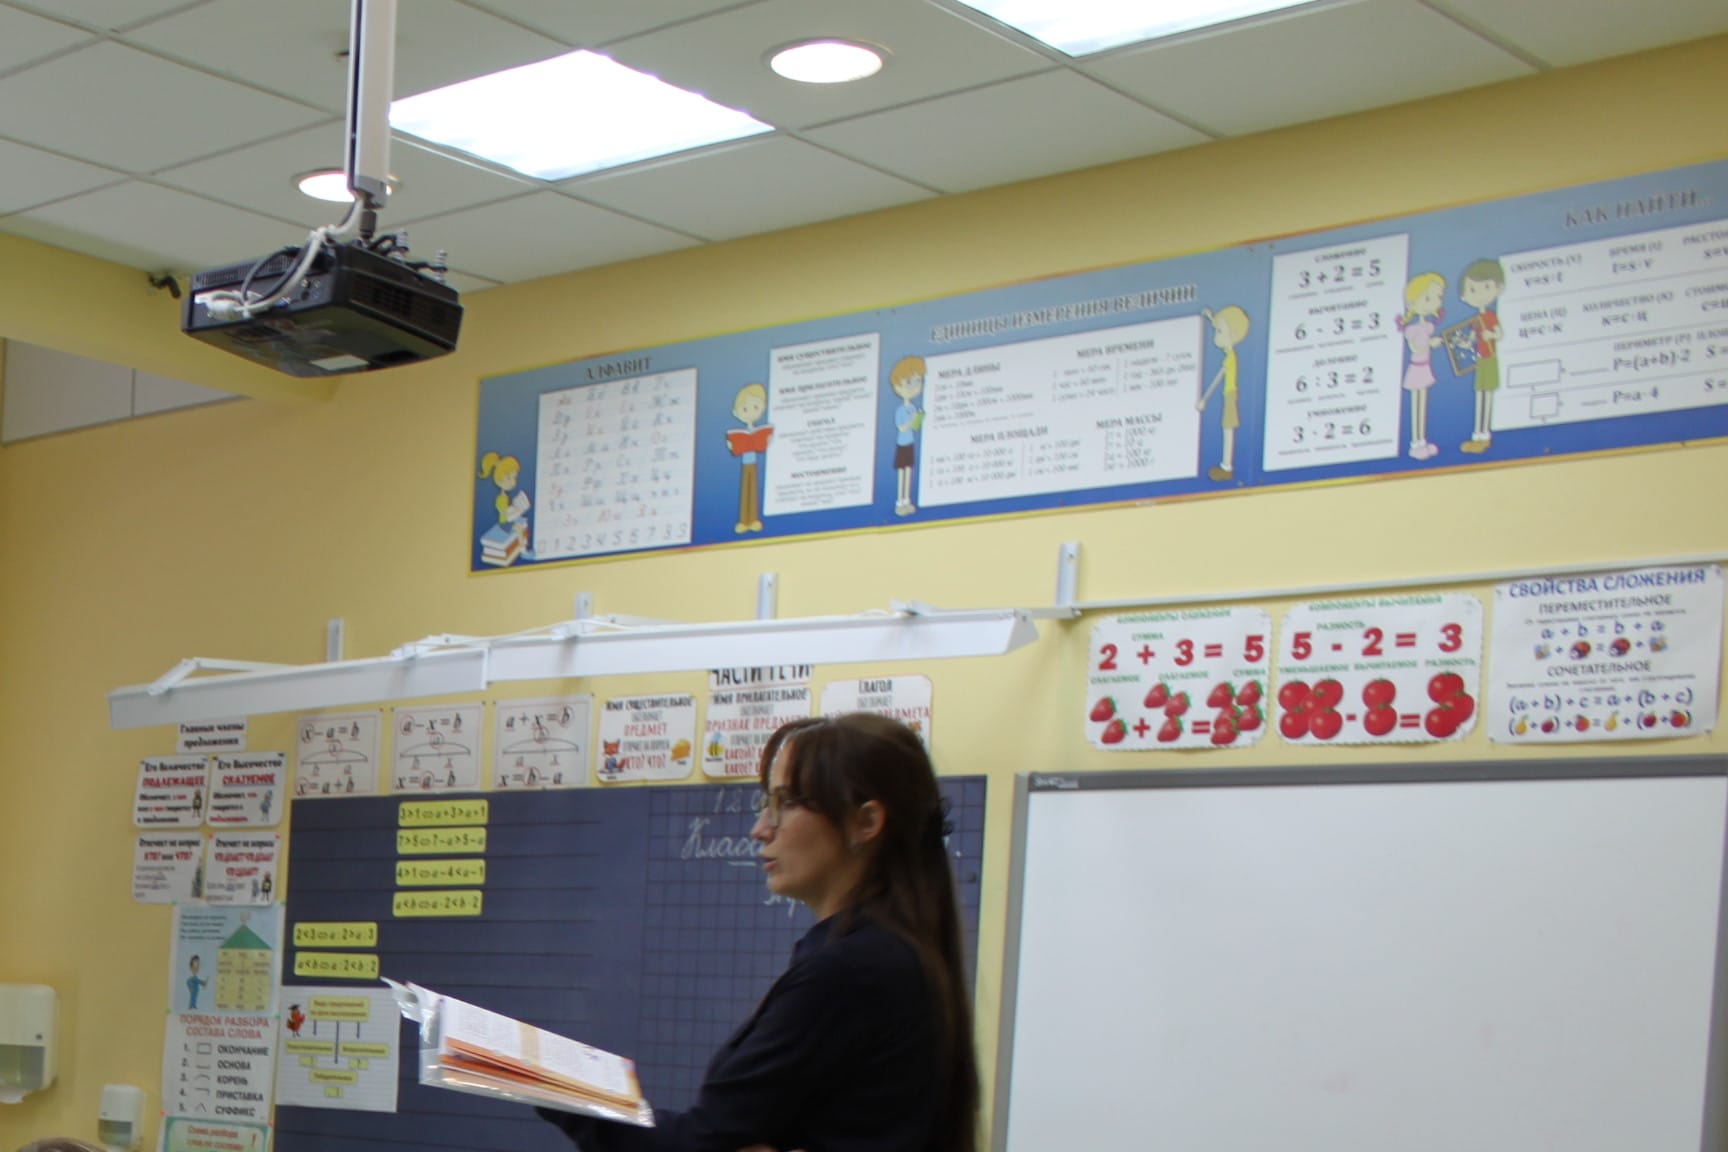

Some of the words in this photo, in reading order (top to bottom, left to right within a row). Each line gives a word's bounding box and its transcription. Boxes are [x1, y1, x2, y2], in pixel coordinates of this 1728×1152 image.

[1299, 271, 1310, 288] 3
[1334, 265, 1345, 282] 2
[1369, 259, 1381, 277] 5
[1295, 323, 1306, 340] 6
[1333, 317, 1344, 335] 3
[1368, 312, 1380, 330] 3
[1295, 376, 1307, 393] 6
[1327, 371, 1338, 389] 3
[1362, 366, 1374, 384] 2
[1293, 426, 1304, 443] 3
[1324, 422, 1335, 440] 2
[1359, 418, 1371, 435] 6
[1509, 577, 1598, 599] СВОЙСТВА
[1603, 568, 1707, 591] СЛОЖЕНИЯ
[1539, 593, 1672, 615] ПЕРЕМЕСТИТЕЛЬНОЕ
[1291, 631, 1313, 660] 5
[1361, 627, 1384, 656] 2
[1438, 623, 1463, 653] 3
[1098, 644, 1118, 671] 2
[1173, 639, 1194, 667] 3
[1243, 635, 1265, 663] 5
[1547, 660, 1652, 678] СОЧЕТАТЕЛЬНОЕ
[624, 722, 667, 737] ПРЕДМЕТ
[142, 776, 205, 788] ПОДЛЕЖАЩЕЕ
[223, 773, 275, 786] СКАЗУЕМОЕ
[179, 1014, 221, 1026] ПОРЯДОК
[224, 1016, 269, 1028] РАЗБОРА
[185, 1026, 225, 1037] СОСТАВА
[227, 1028, 262, 1039] СЛОВА
[217, 1044, 269, 1056] ОКОНЧАНИЕ
[217, 1060, 251, 1070] ОСНОВА
[216, 1075, 248, 1086] КОРЕНЬ
[216, 1090, 264, 1102] ПРИСТАВКА
[215, 1105, 256, 1117] СУФФИКС
